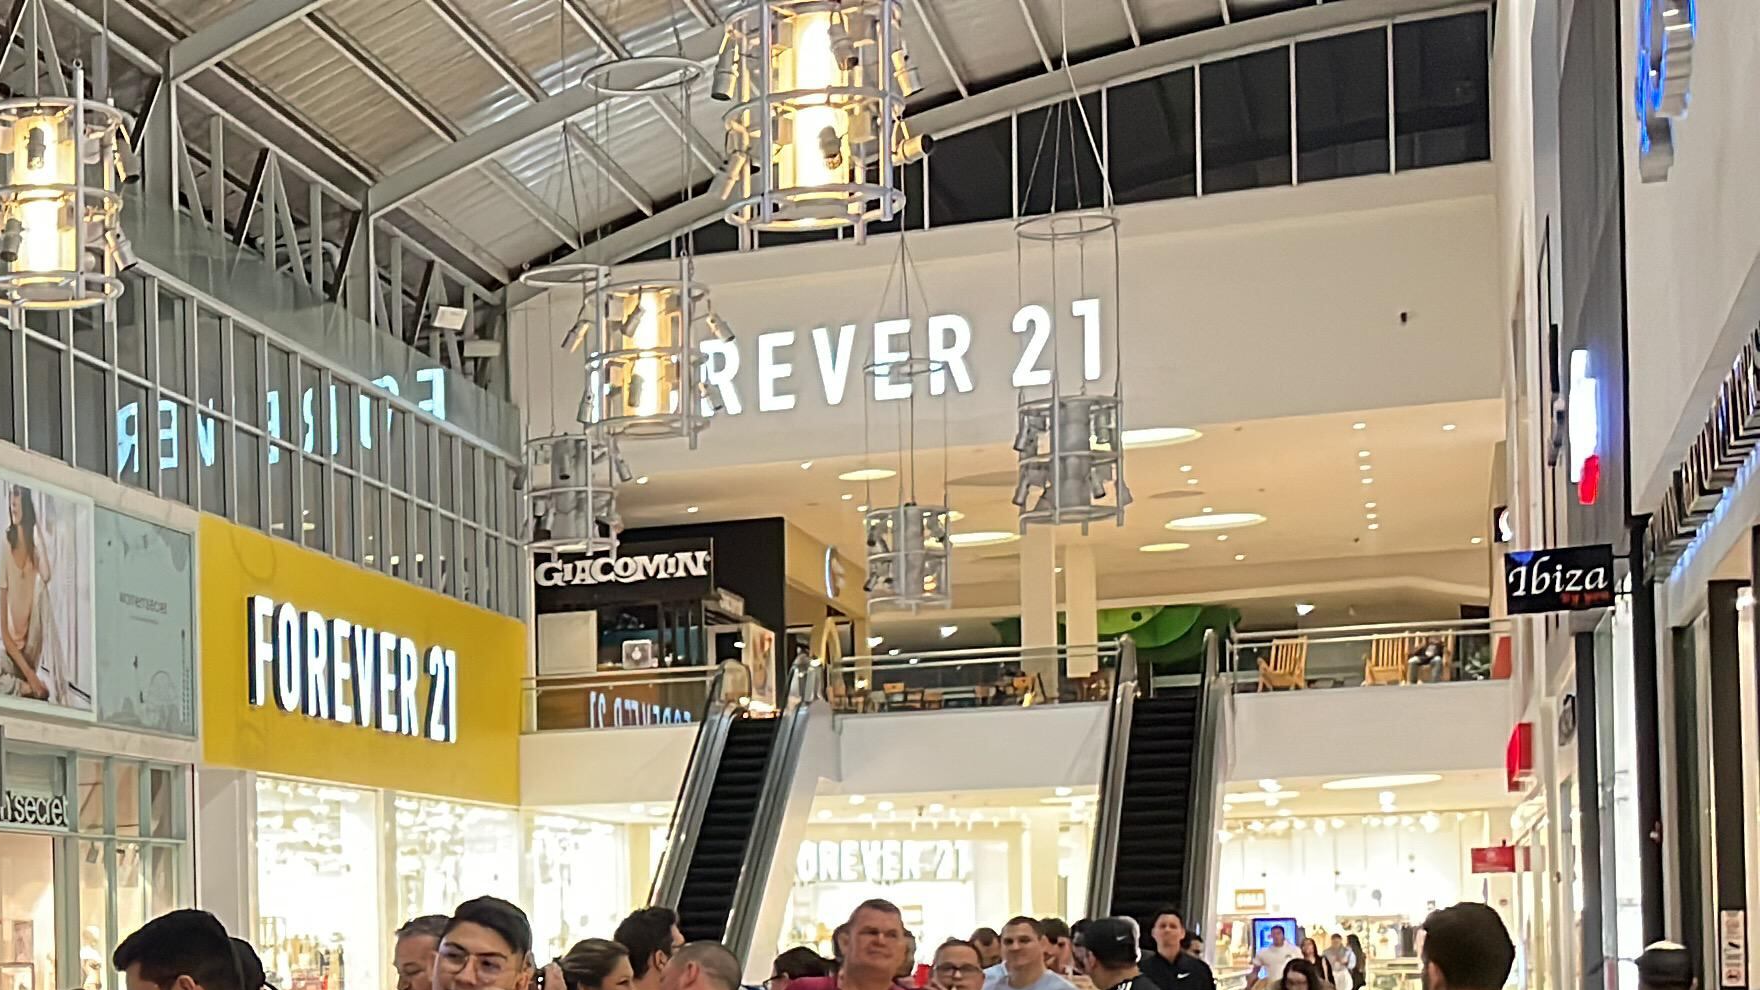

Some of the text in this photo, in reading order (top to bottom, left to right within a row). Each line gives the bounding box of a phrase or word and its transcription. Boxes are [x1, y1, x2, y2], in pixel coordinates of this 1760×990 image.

[590, 297, 1102, 424] REVER 21
[1508, 554, 1608, 597] Ibiza
[247, 594, 419, 738] FOREVER
[424, 644, 458, 744] 21
